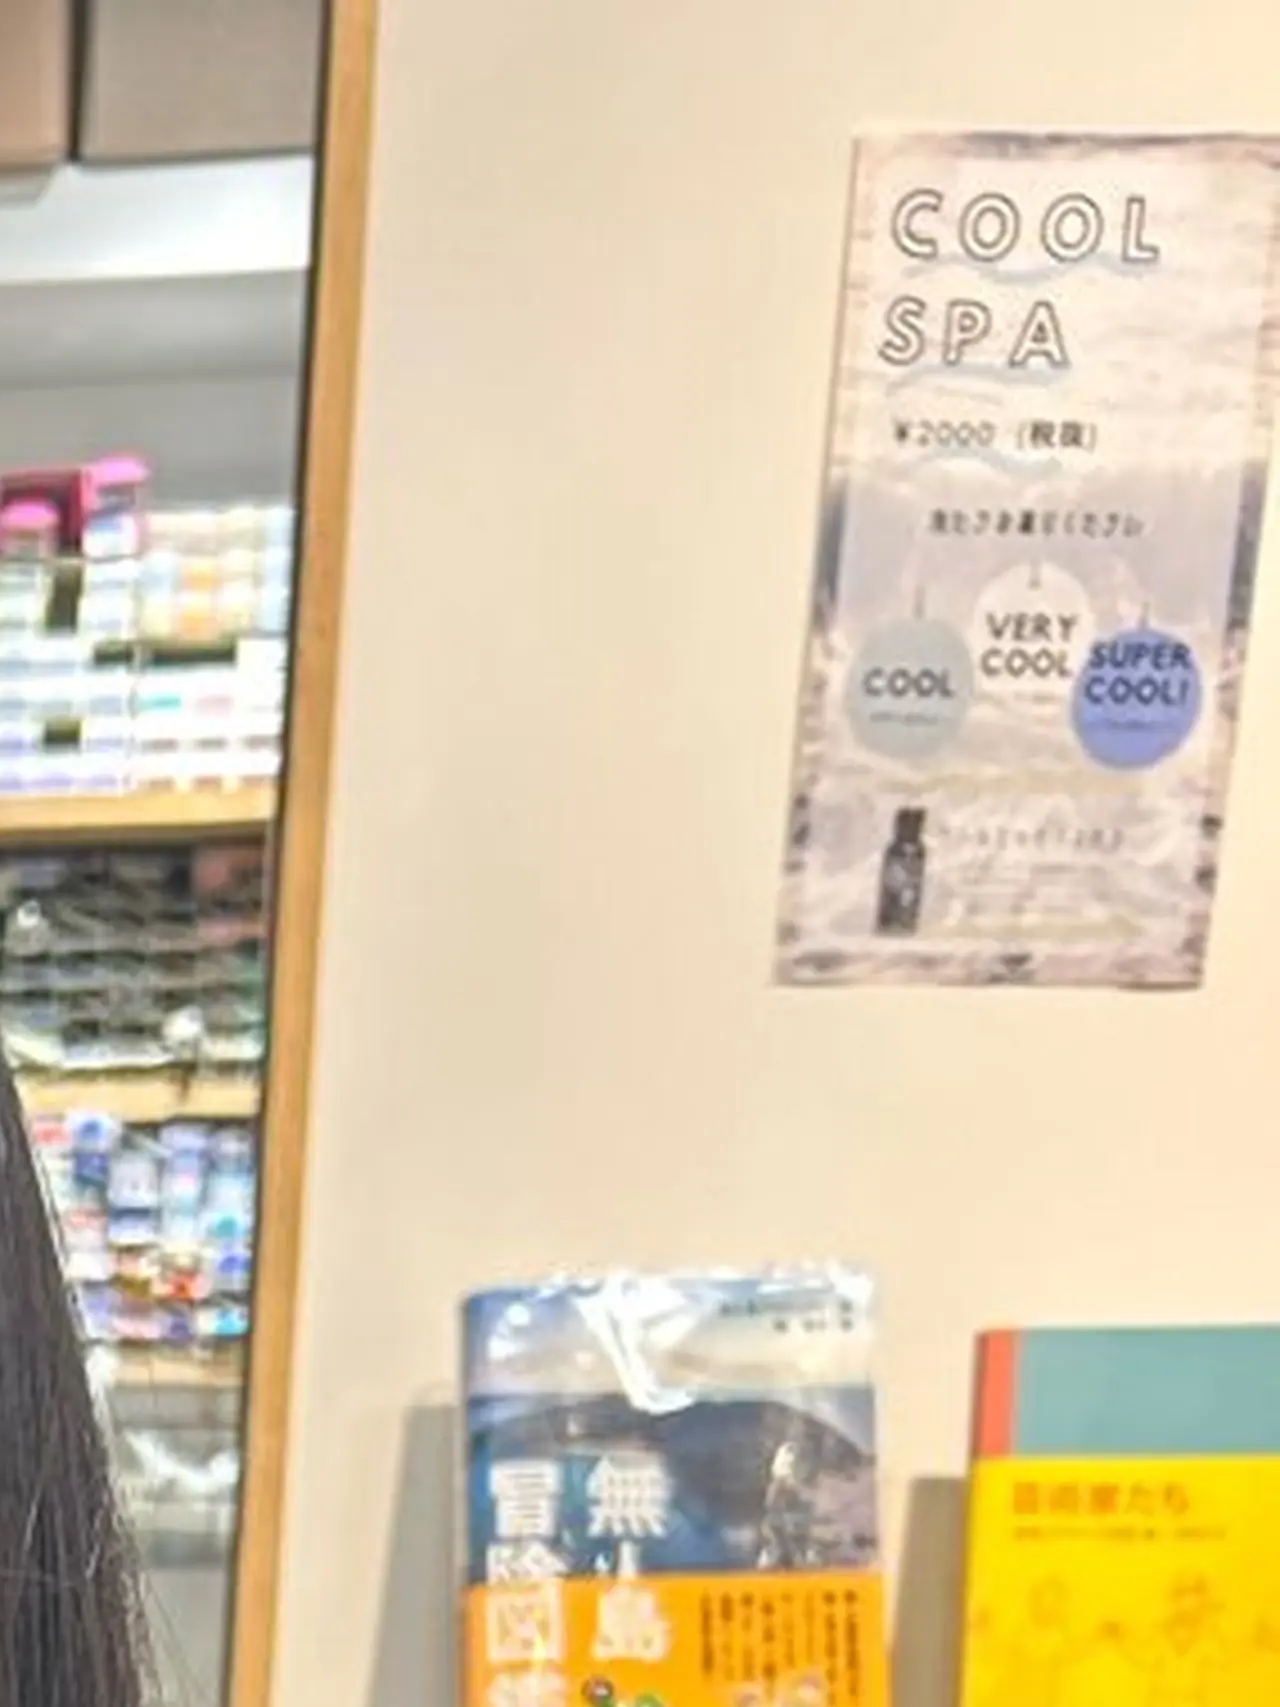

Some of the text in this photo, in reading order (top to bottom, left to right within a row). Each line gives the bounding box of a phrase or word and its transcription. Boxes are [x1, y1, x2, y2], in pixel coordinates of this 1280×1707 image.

[891, 187, 1160, 264] COOL
[878, 296, 1071, 369] SPA
[892, 416, 996, 448] ¥2000
[985, 611, 1080, 643] VERY
[980, 647, 1074, 679] COOL
[1089, 640, 1194, 671] SUPER
[862, 667, 958, 699] COOL
[1083, 675, 1191, 707] COOL!
